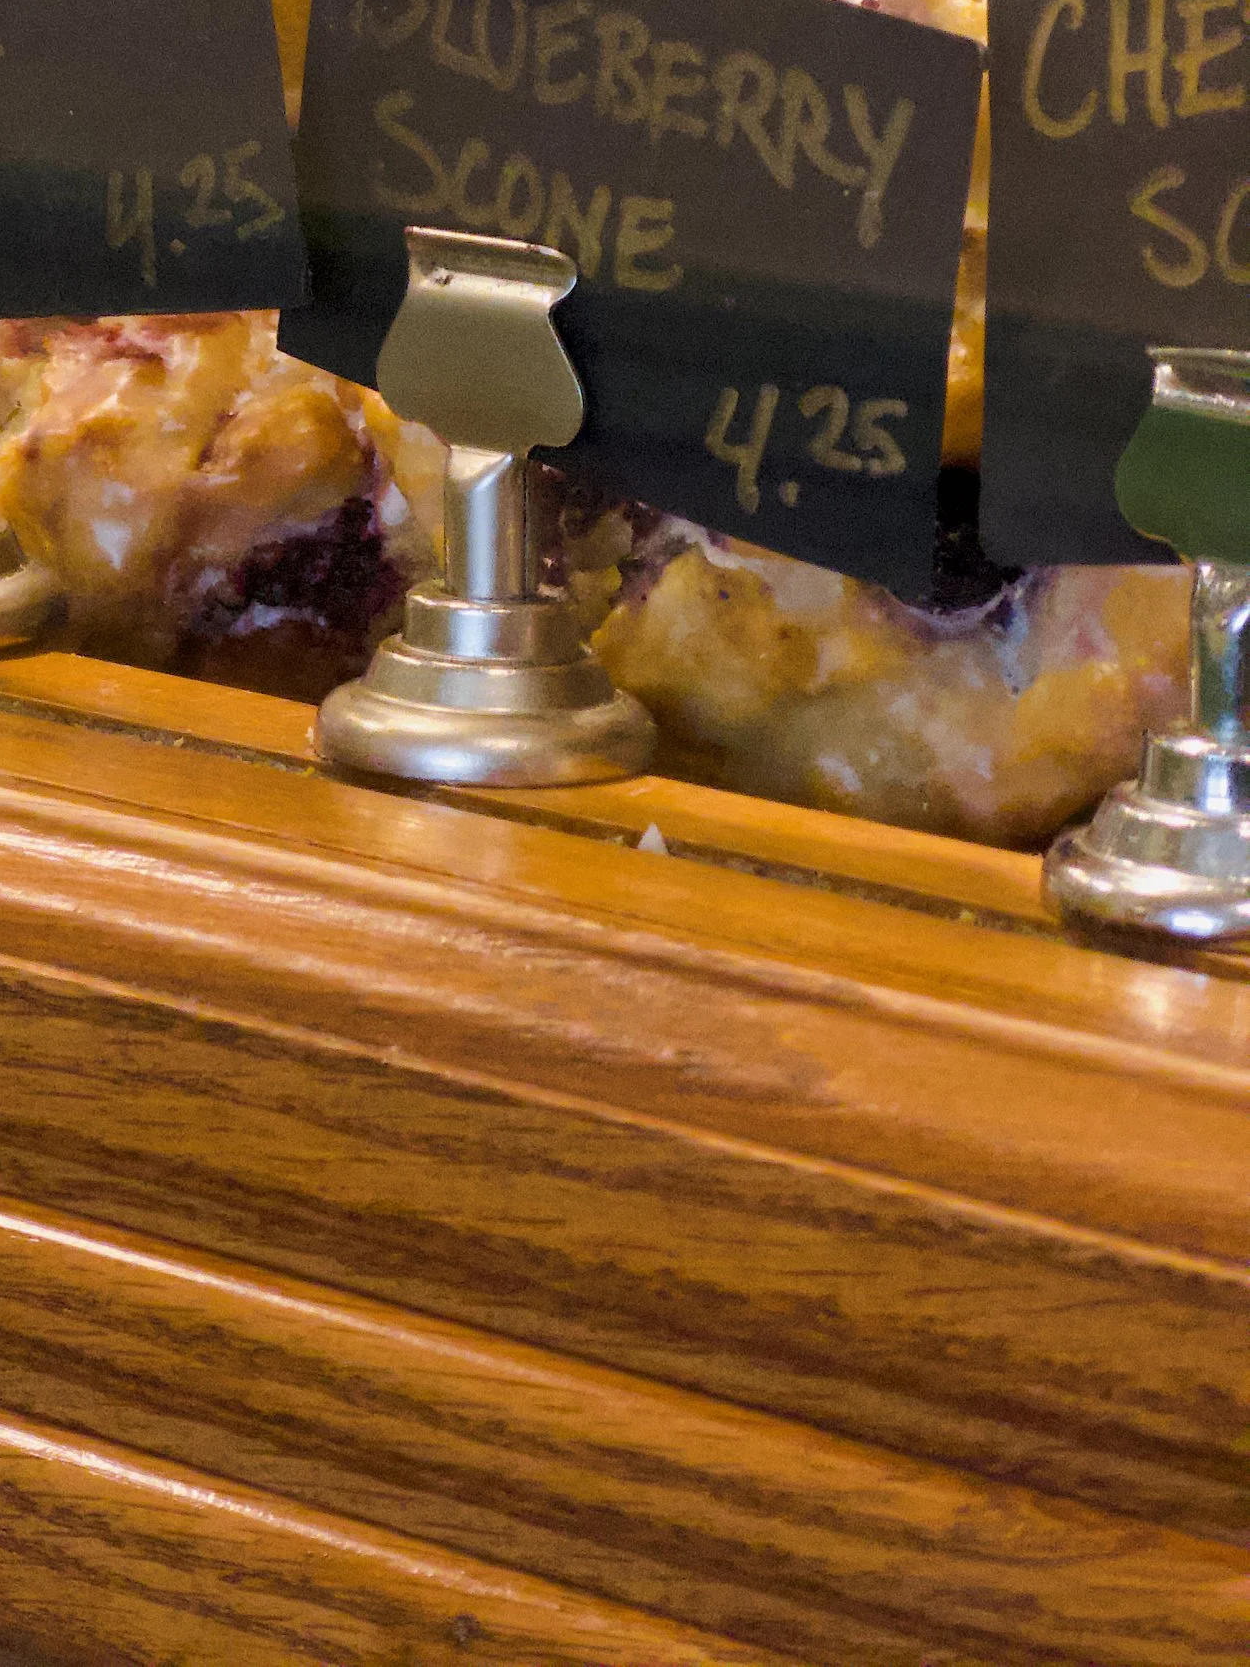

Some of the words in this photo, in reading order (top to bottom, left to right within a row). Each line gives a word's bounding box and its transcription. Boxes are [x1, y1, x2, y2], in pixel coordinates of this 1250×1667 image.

[106, 140, 286, 286] 4.25
[370, 90, 684, 291] SCONE
[705, 384, 909, 514] 4.25
